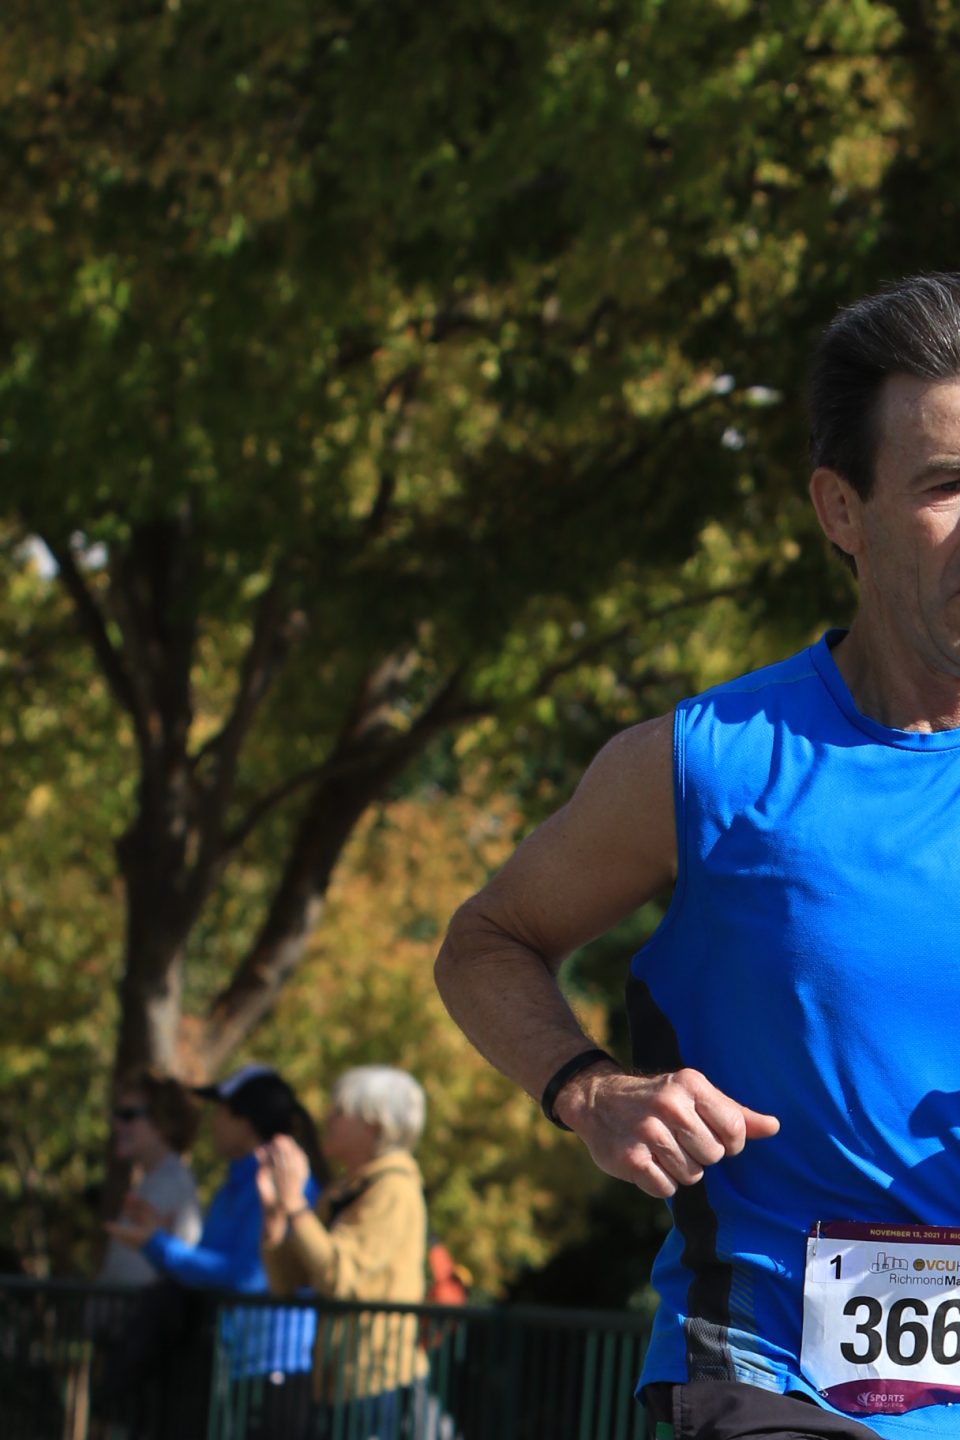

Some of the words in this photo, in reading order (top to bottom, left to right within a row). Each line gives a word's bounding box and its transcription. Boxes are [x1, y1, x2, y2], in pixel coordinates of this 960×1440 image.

[869, 1228, 912, 1238] NOVEMBER
[912, 1231, 922, 1239] 13,
[923, 1230, 940, 1239] 2021
[830, 1254, 842, 1280] 1
[869, 1393, 905, 1403] SPORTS
